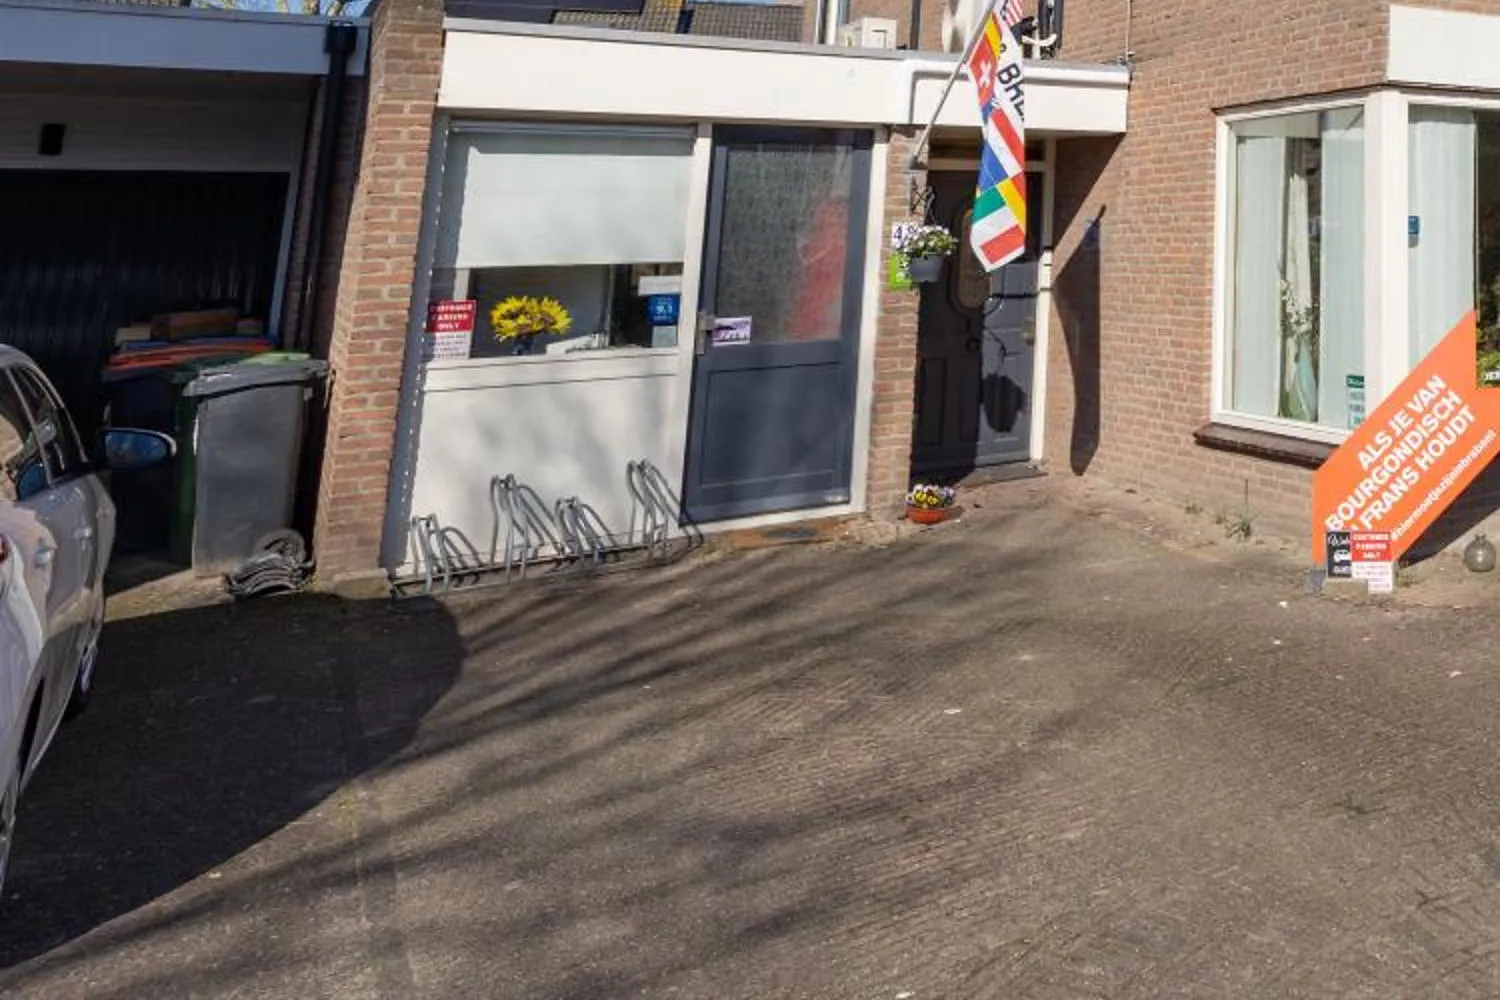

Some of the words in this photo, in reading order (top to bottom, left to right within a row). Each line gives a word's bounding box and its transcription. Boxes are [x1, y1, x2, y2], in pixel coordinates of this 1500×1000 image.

[1325, 391, 1462, 531] BOURGONDISCH
[1357, 431, 1393, 471] ALS
[1388, 409, 1415, 436] JE
[1407, 375, 1447, 414] VAN
[1359, 466, 1420, 530] FRANS
[1414, 404, 1475, 472] HOUDT
